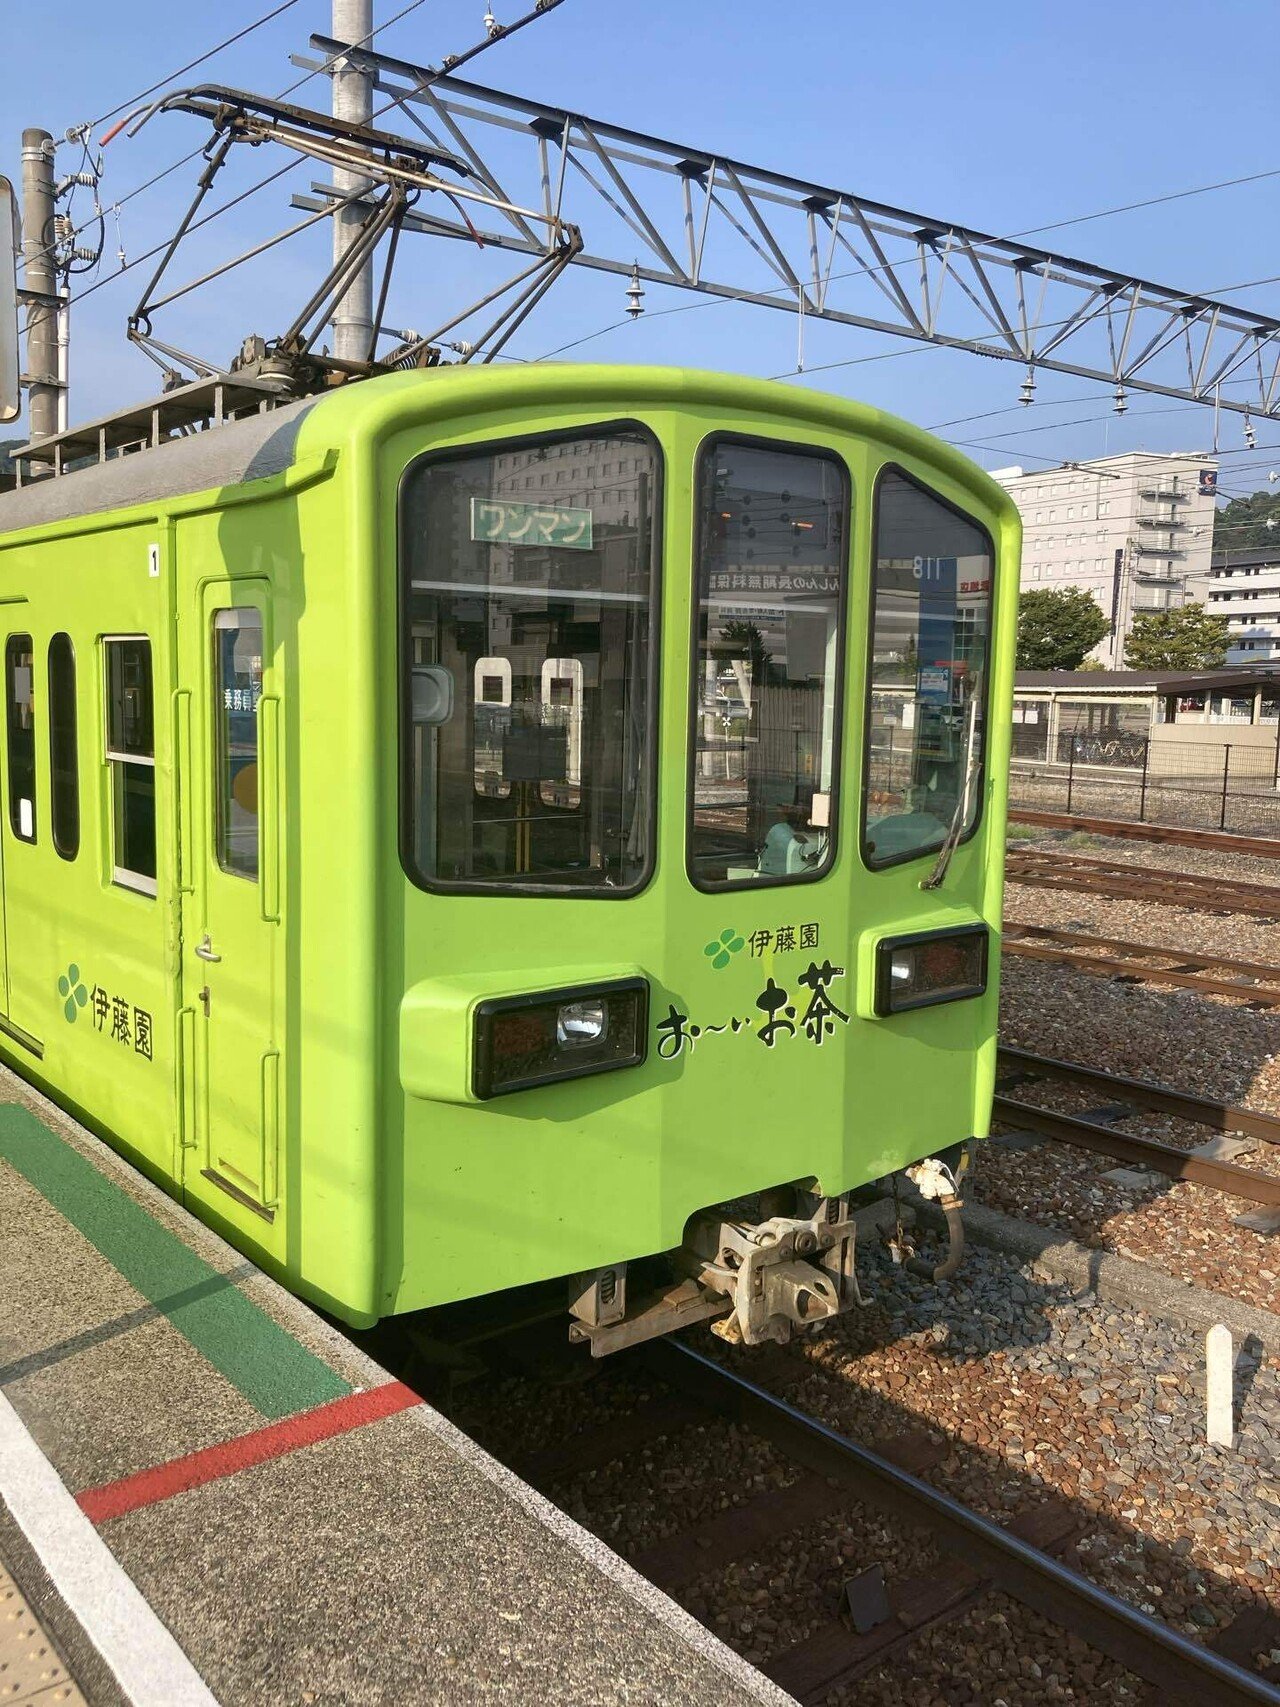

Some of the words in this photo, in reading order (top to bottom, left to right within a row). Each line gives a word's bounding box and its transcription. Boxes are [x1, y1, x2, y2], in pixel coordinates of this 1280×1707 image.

[480, 505, 585, 542] ワンマン
[152, 550, 157, 572] 1
[748, 922, 820, 958] 伊藤園
[90, 983, 153, 1062] 伊藤園
